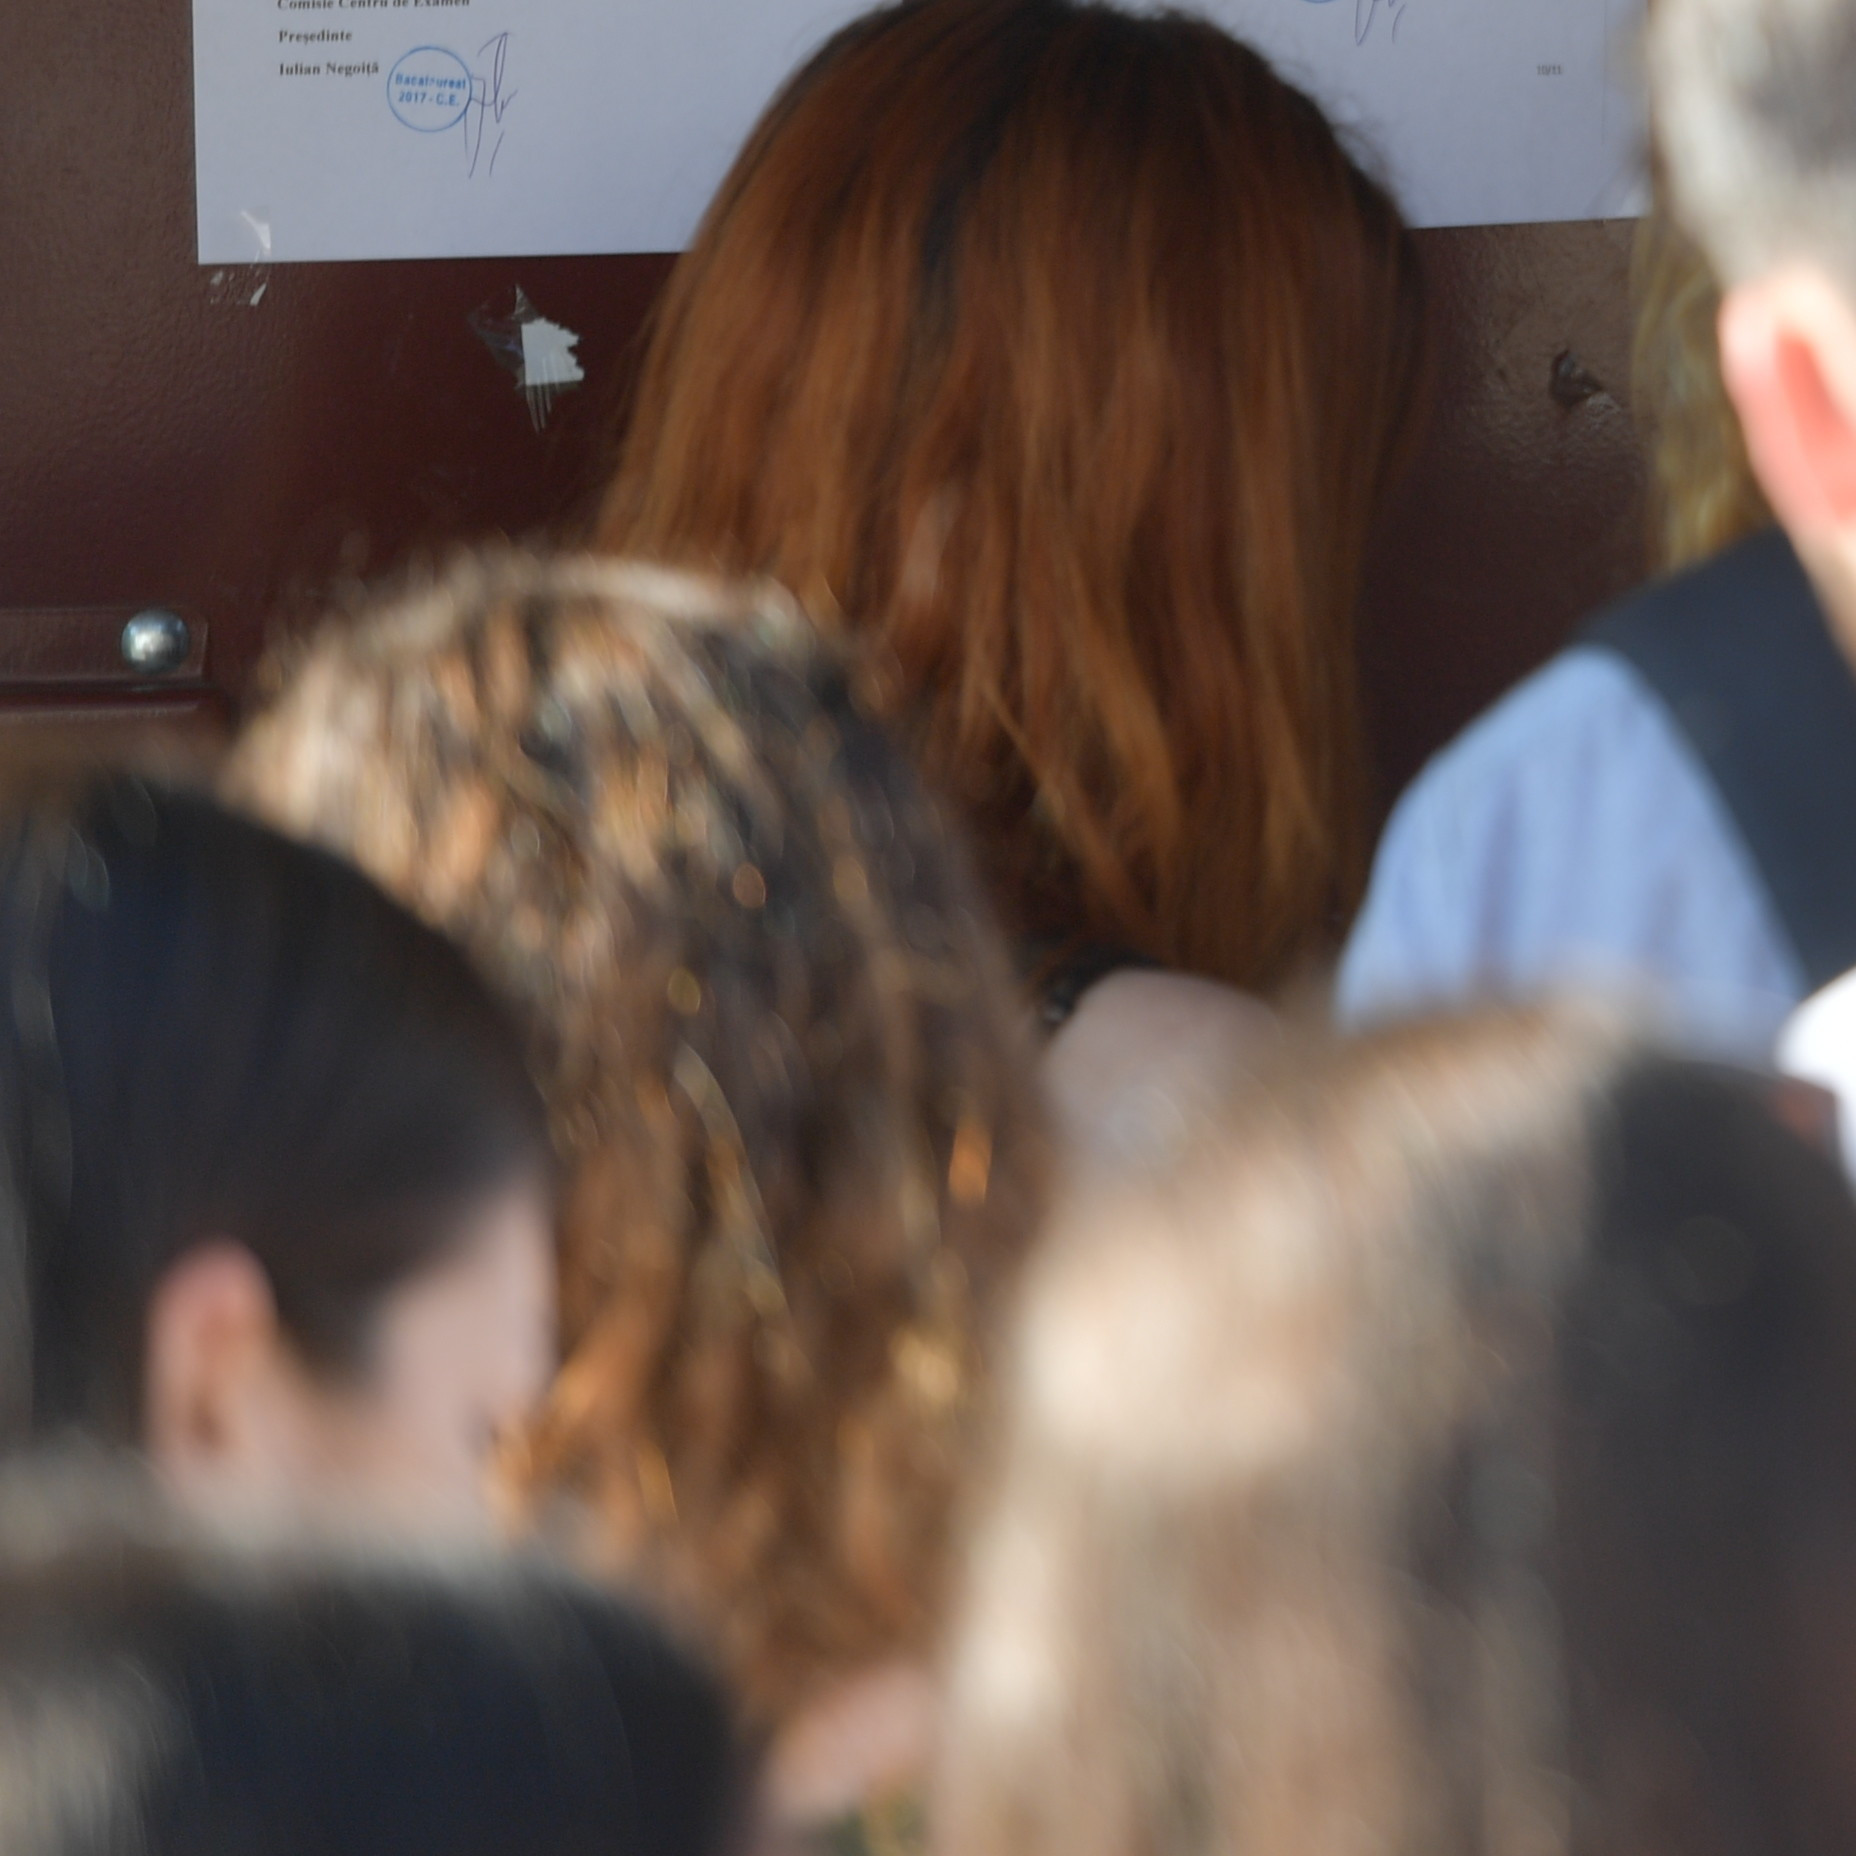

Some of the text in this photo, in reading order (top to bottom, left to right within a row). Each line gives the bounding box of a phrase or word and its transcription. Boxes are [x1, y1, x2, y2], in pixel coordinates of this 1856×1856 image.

[278, 30, 353, 45] Președinte
[279, 61, 380, 78] Iulian Negoiță
[398, 91, 427, 104] 2017
[436, 93, 461, 107] C.E.
